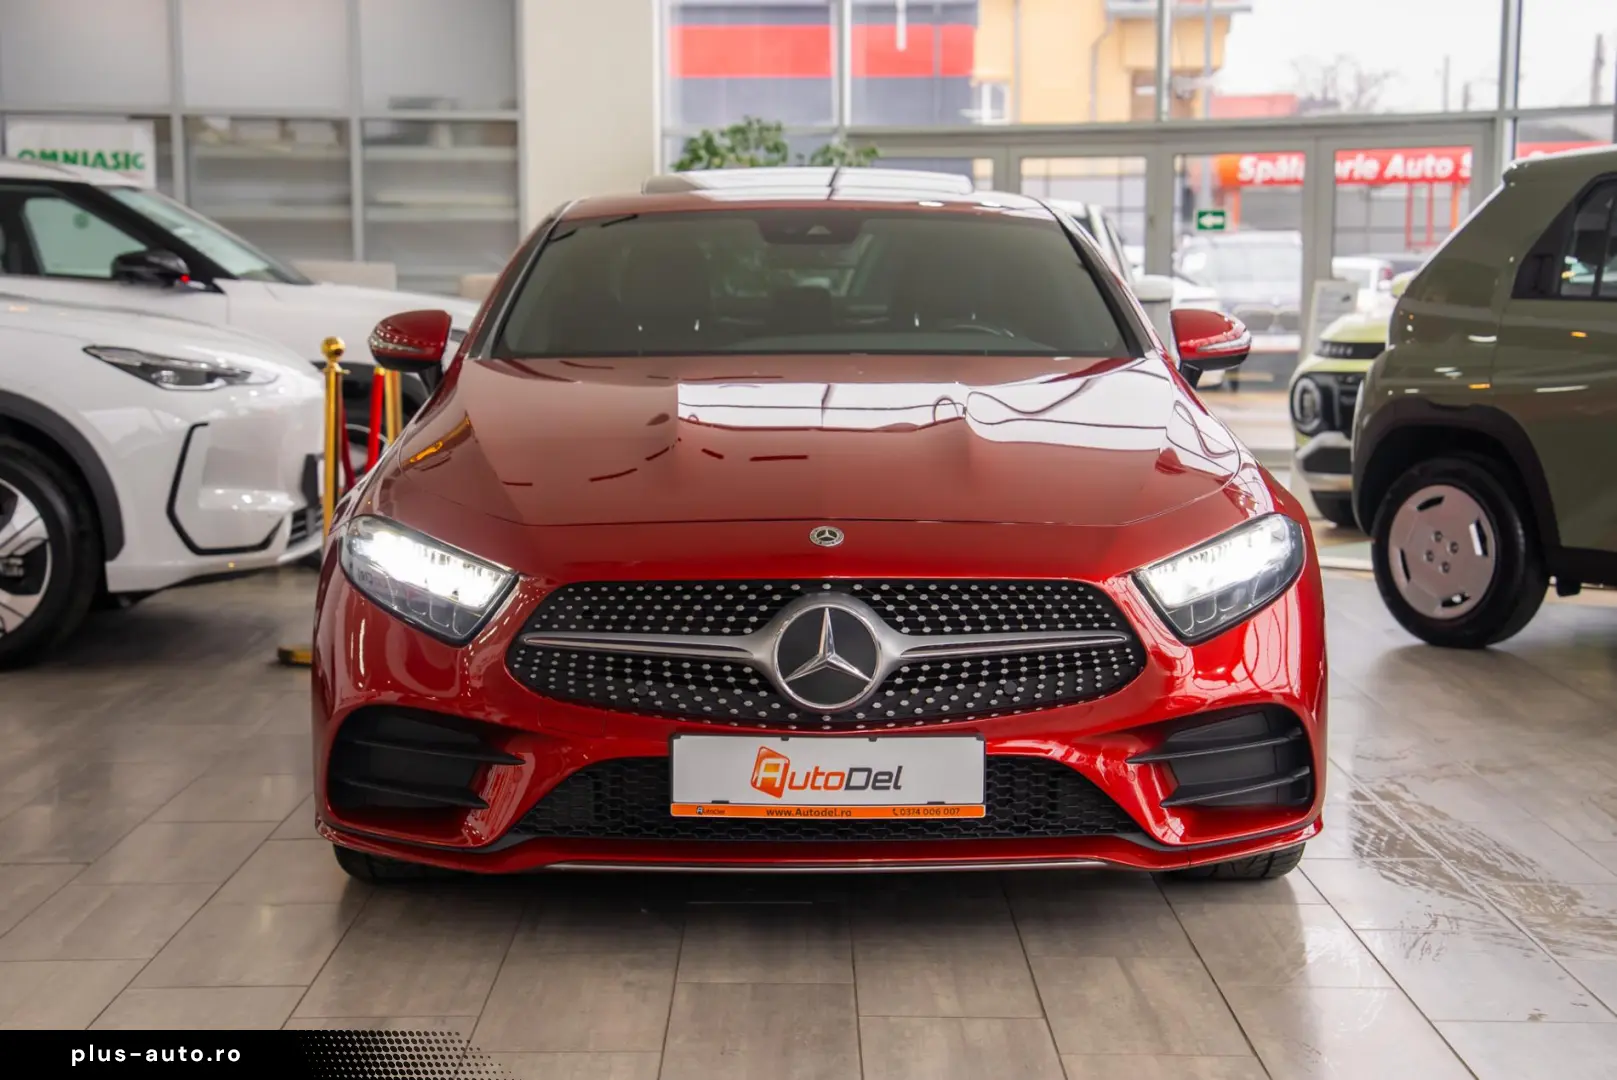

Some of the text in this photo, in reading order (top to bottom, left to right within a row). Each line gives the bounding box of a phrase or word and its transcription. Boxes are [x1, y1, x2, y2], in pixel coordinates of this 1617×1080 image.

[1384, 153, 1454, 180] Auto
[752, 749, 903, 797] AutoDel
[766, 807, 852, 818] www.Autodel.ro
